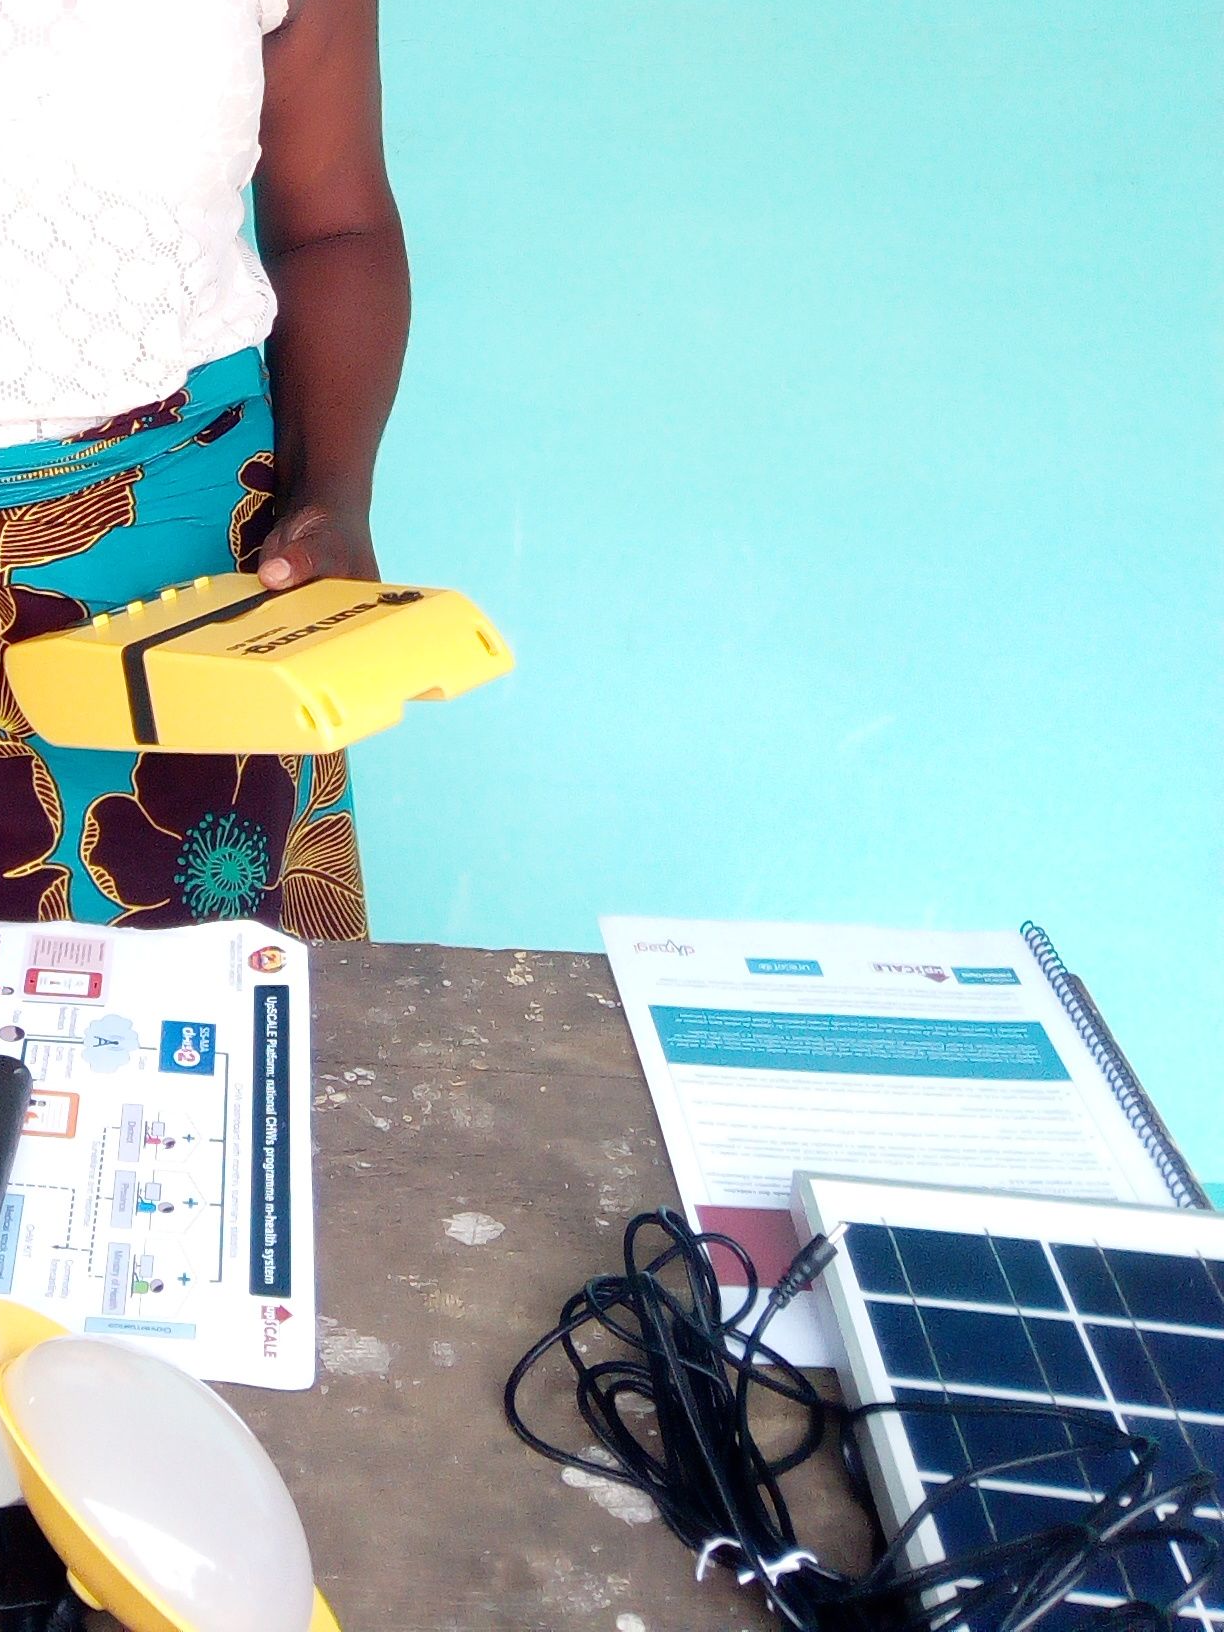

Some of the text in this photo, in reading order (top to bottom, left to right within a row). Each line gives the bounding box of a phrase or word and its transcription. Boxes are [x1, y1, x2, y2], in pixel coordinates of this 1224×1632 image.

[241, 603, 378, 656] sun king
[263, 996, 278, 1284] UpSCALE Platform: national CHWs programme m-health system
